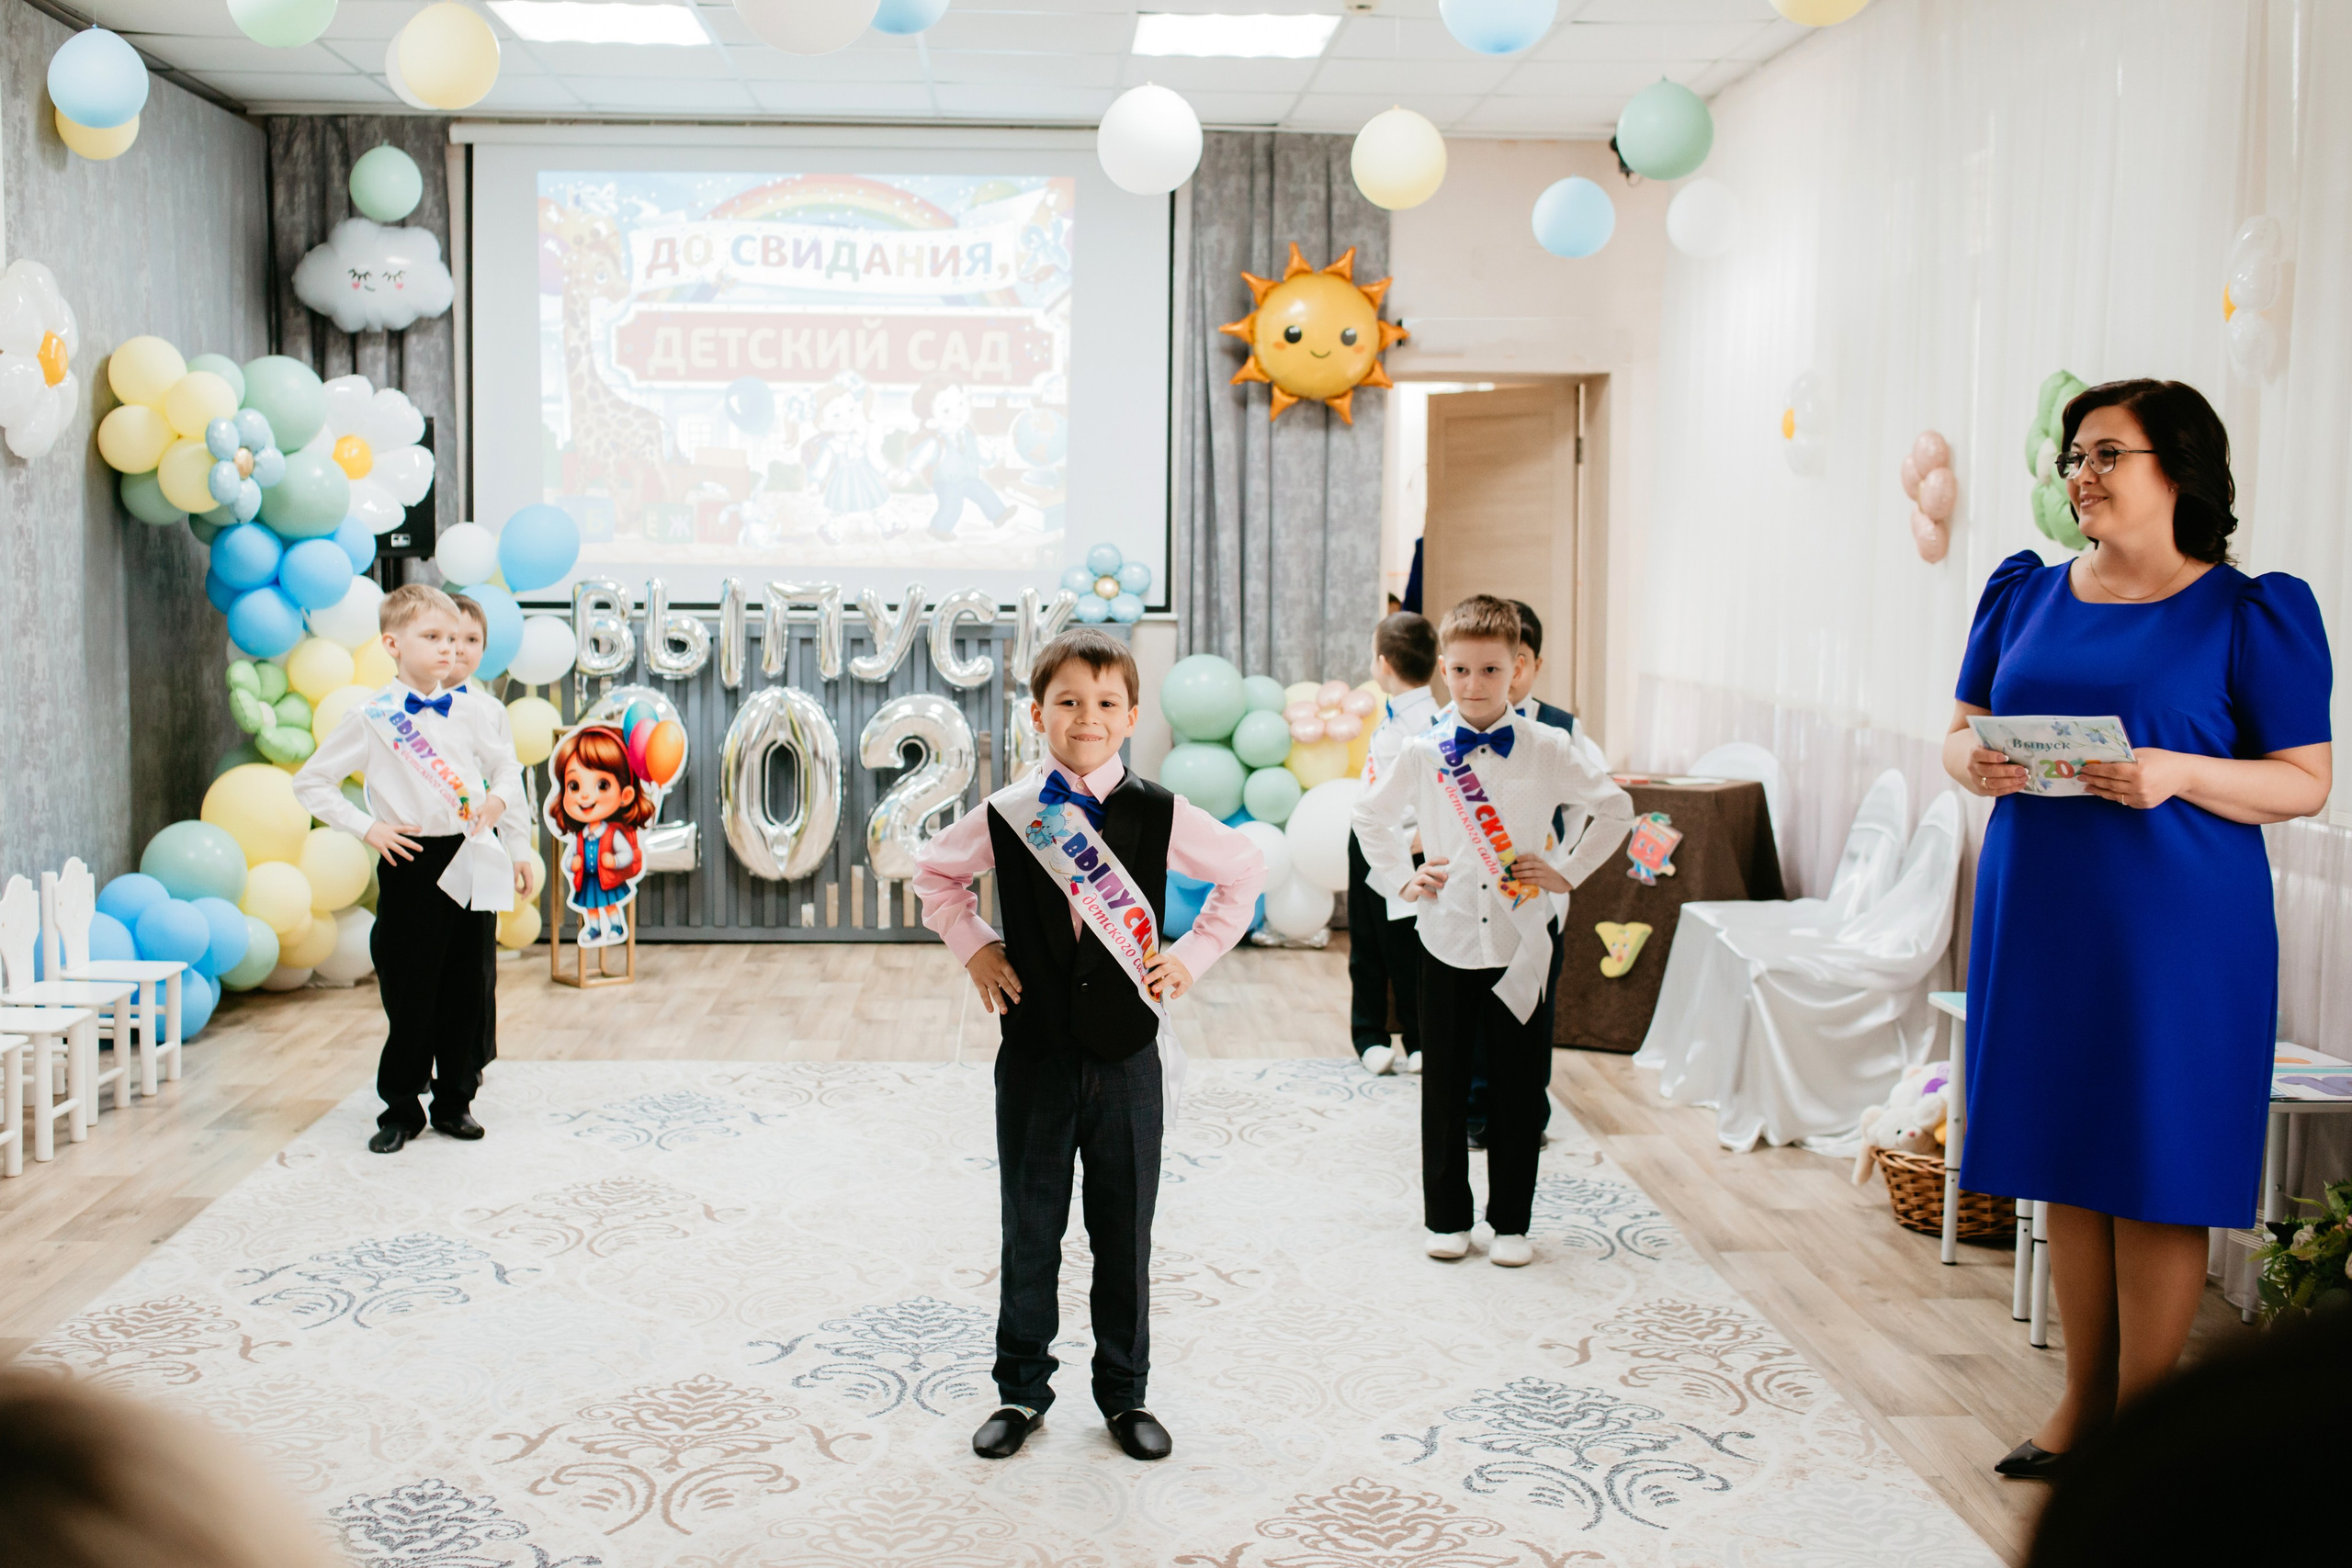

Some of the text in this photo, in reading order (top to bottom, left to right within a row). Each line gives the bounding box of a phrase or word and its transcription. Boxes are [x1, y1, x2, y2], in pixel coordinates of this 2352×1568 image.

[645, 232, 1011, 282] ДО СВИДАНИЯ,
[646, 317, 1012, 380] ДЕТСКИЙ САД
[668, 514, 691, 537] Ж
[571, 575, 1079, 690] ВЫПУСК
[2012, 738, 2071, 751] Выпуск
[2039, 757, 2101, 779] 202
[577, 683, 1049, 881] 202
[1445, 785, 1499, 875] детского сада
[1062, 831, 1158, 970] ВЫПУСКН
[1082, 892, 1136, 957] детского
